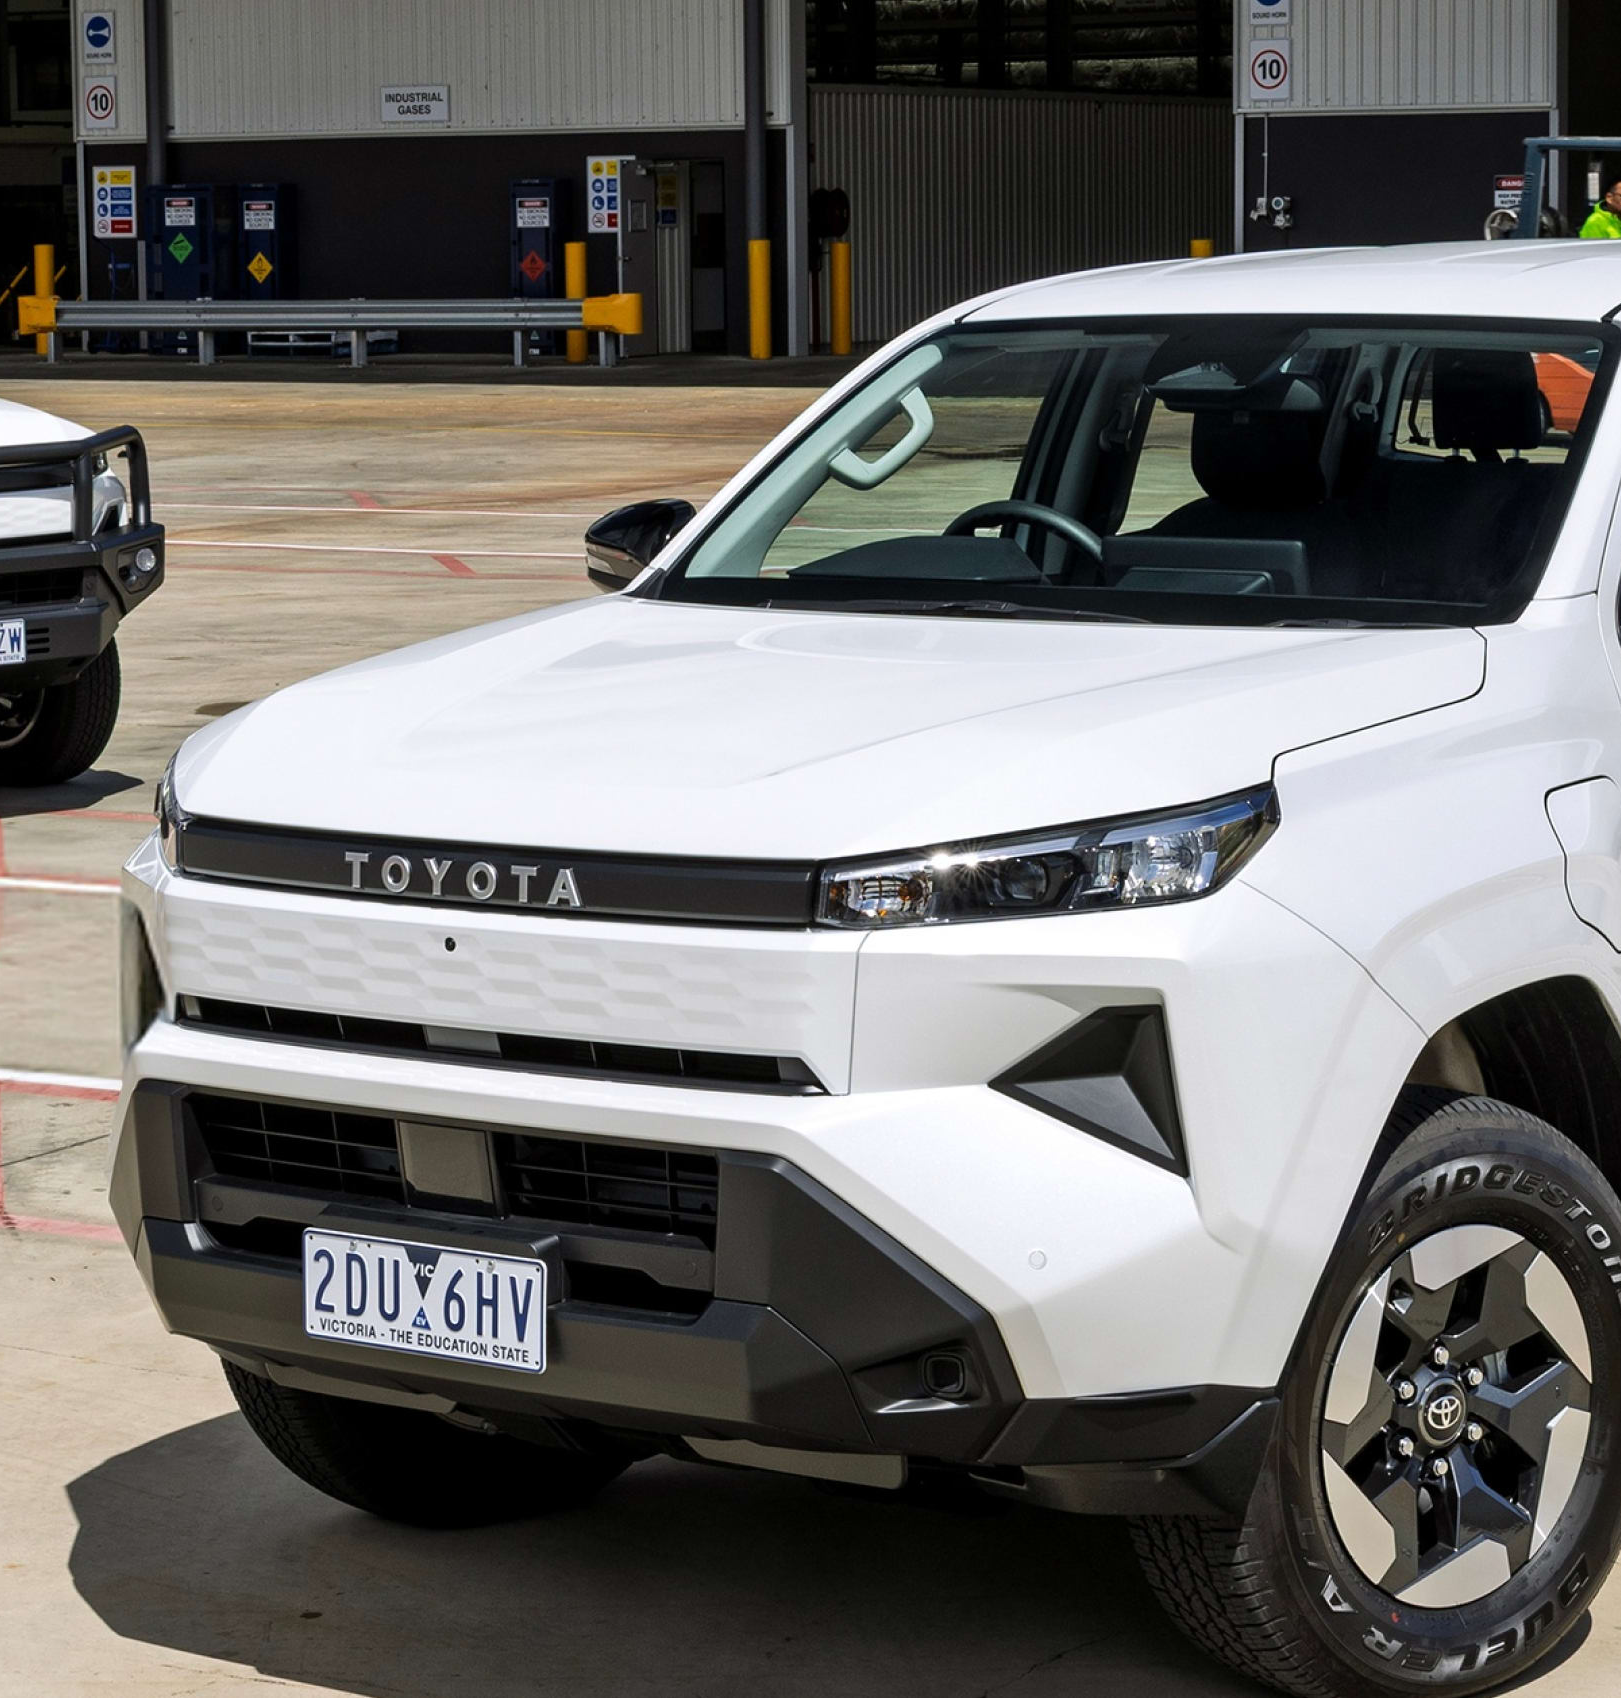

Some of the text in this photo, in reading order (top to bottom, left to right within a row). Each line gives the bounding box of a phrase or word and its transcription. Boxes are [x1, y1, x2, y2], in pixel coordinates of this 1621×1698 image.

[1258, 59, 1281, 80] 10
[91, 93, 109, 112] 10
[384, 92, 444, 103] INDUSTRIAL
[397, 104, 431, 115] GASES
[345, 851, 582, 907] TOYOTA
[412, 1262, 435, 1278] VIC
[313, 1249, 533, 1343] 2DU 6HV
[415, 1316, 427, 1326] EV
[319, 1318, 377, 1339] VICTORIA
[389, 1328, 413, 1345] THE
[417, 1333, 488, 1357] EDUCATION
[492, 1345, 529, 1363] STATE
